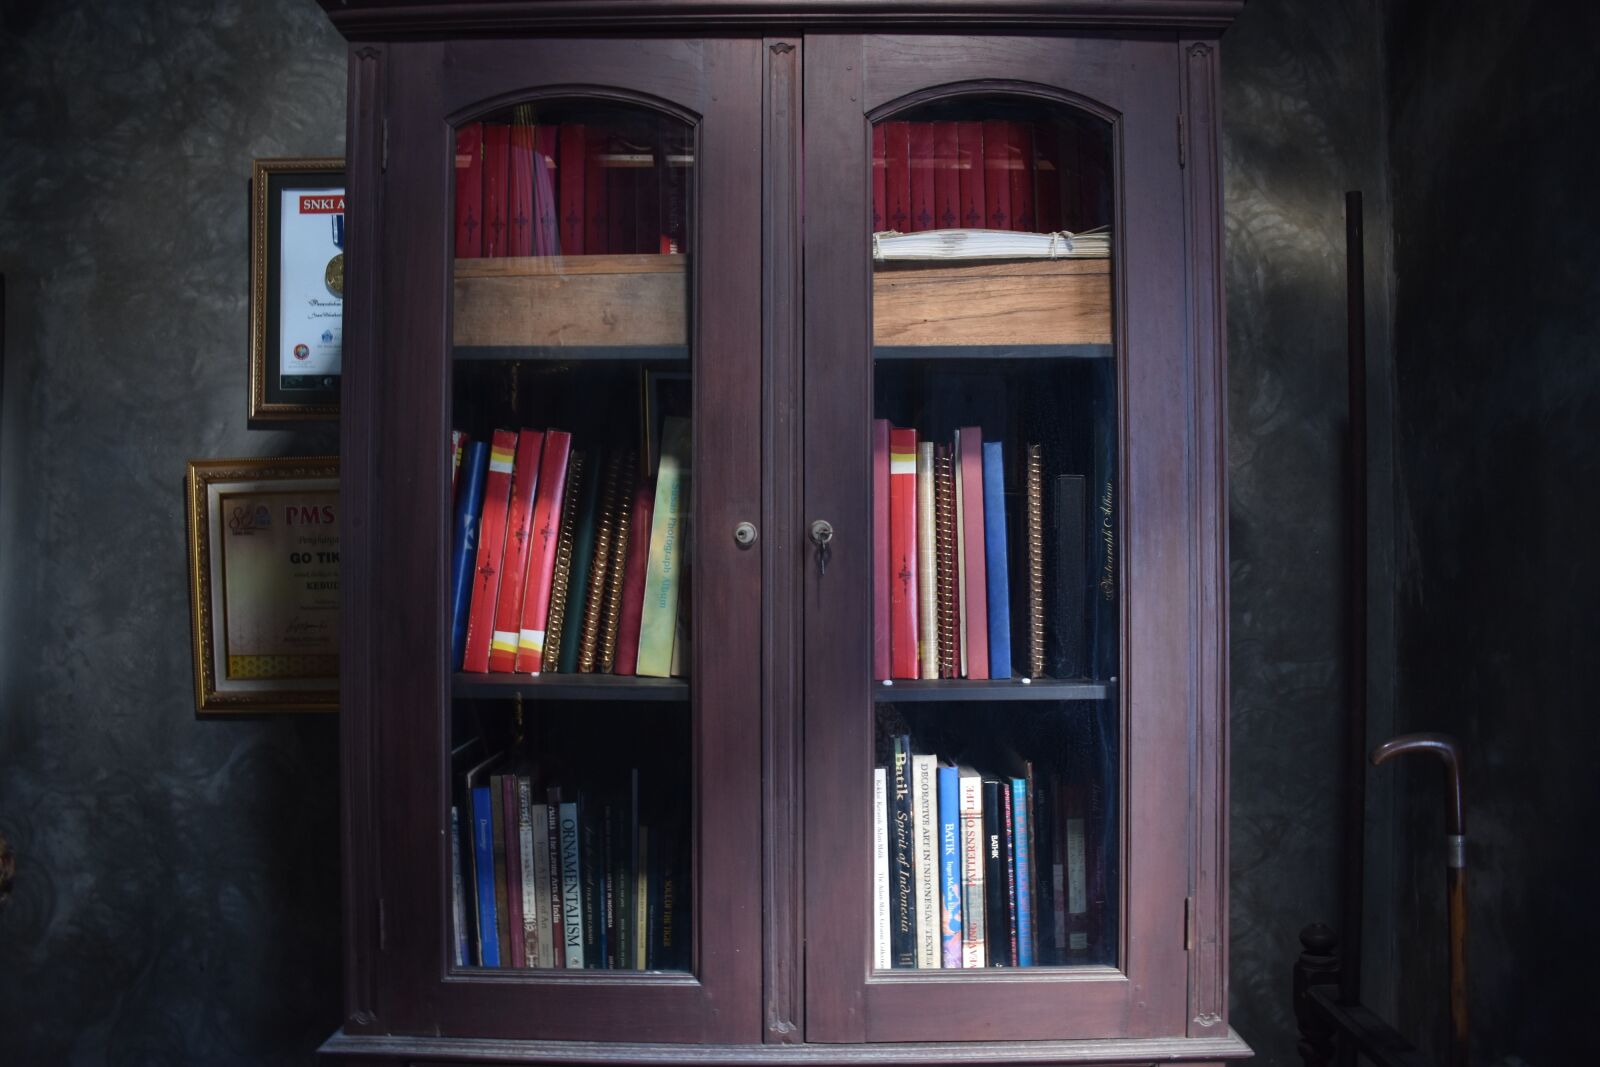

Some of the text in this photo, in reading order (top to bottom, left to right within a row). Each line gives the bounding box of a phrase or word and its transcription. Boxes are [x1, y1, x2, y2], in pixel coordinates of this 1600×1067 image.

[304, 199, 334, 210] SNKI
[286, 505, 335, 525] PMS
[659, 483, 679, 609] Susan Photograph Album
[1100, 481, 1115, 600] Photograph Album
[290, 552, 312, 564] GO
[966, 786, 975, 810] LIFE
[550, 836, 558, 849] The
[895, 752, 911, 933] Batik Spirit of Indonesia
[945, 823, 954, 856] BATIK
[990, 834, 998, 858] BATHIK
[550, 852, 558, 876] Living
[920, 763, 934, 967] DECORATIVE ART IN INDONESIAN TEXTILE
[946, 860, 954, 877] Inger
[967, 830, 976, 887] PATTERNS
[562, 819, 580, 948] ORNAMENTALISM
[552, 894, 560, 902] of
[553, 904, 561, 923] India
